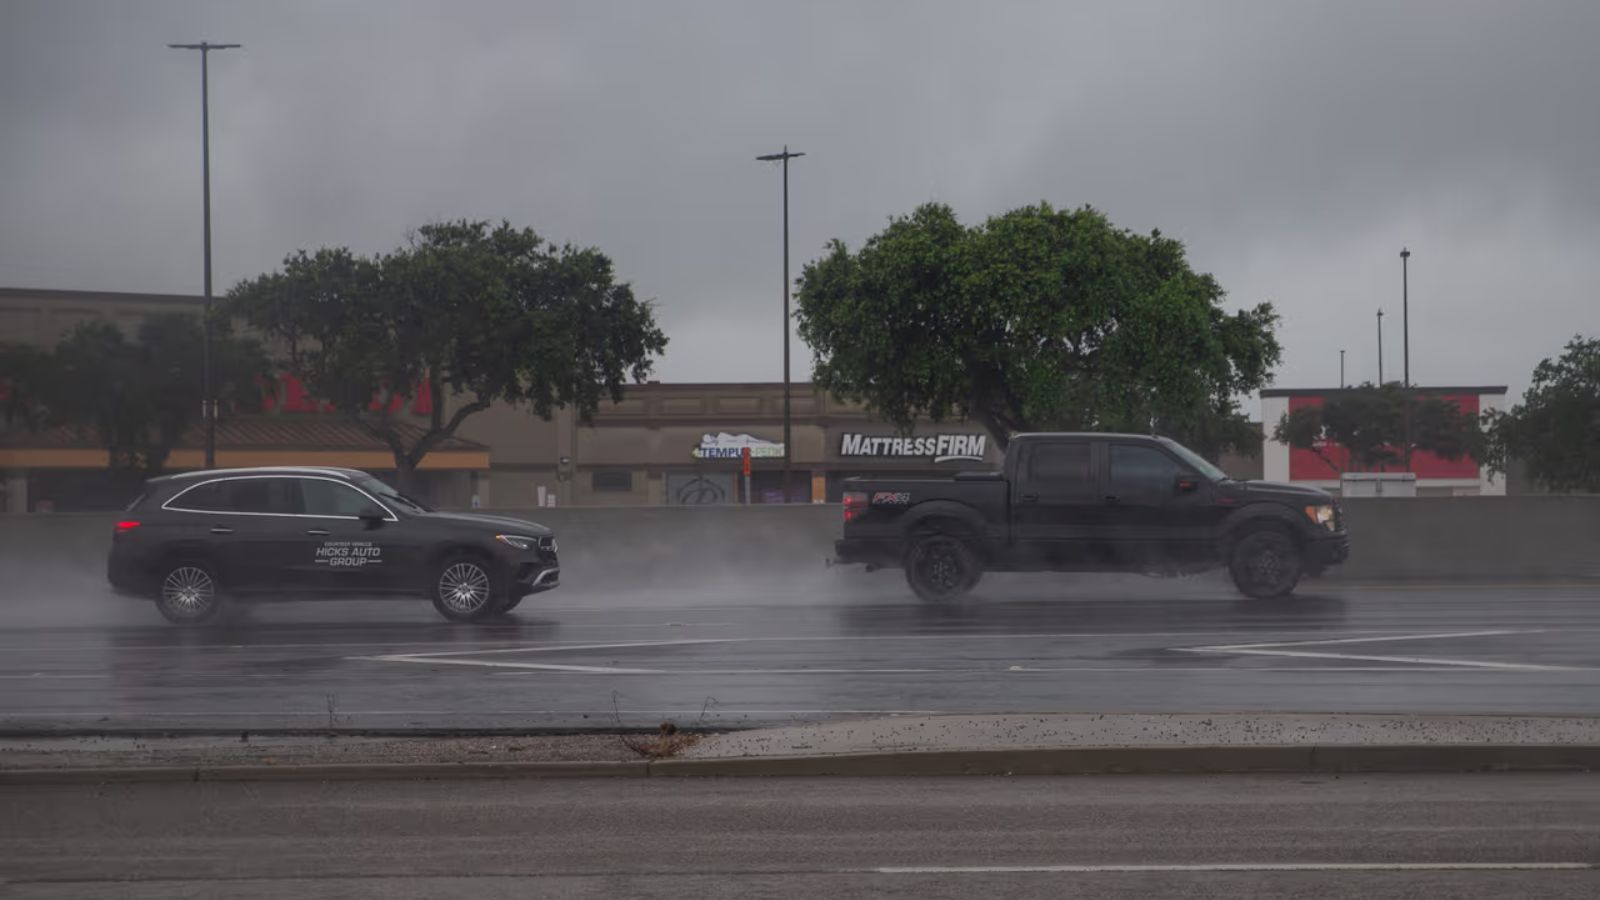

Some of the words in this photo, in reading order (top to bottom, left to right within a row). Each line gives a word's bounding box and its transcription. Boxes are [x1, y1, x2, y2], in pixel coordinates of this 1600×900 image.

[872, 492, 911, 504] FX4
[316, 547, 349, 557] HICKS
[351, 547, 381, 557] AUTO
[329, 557, 367, 566] GROUP
